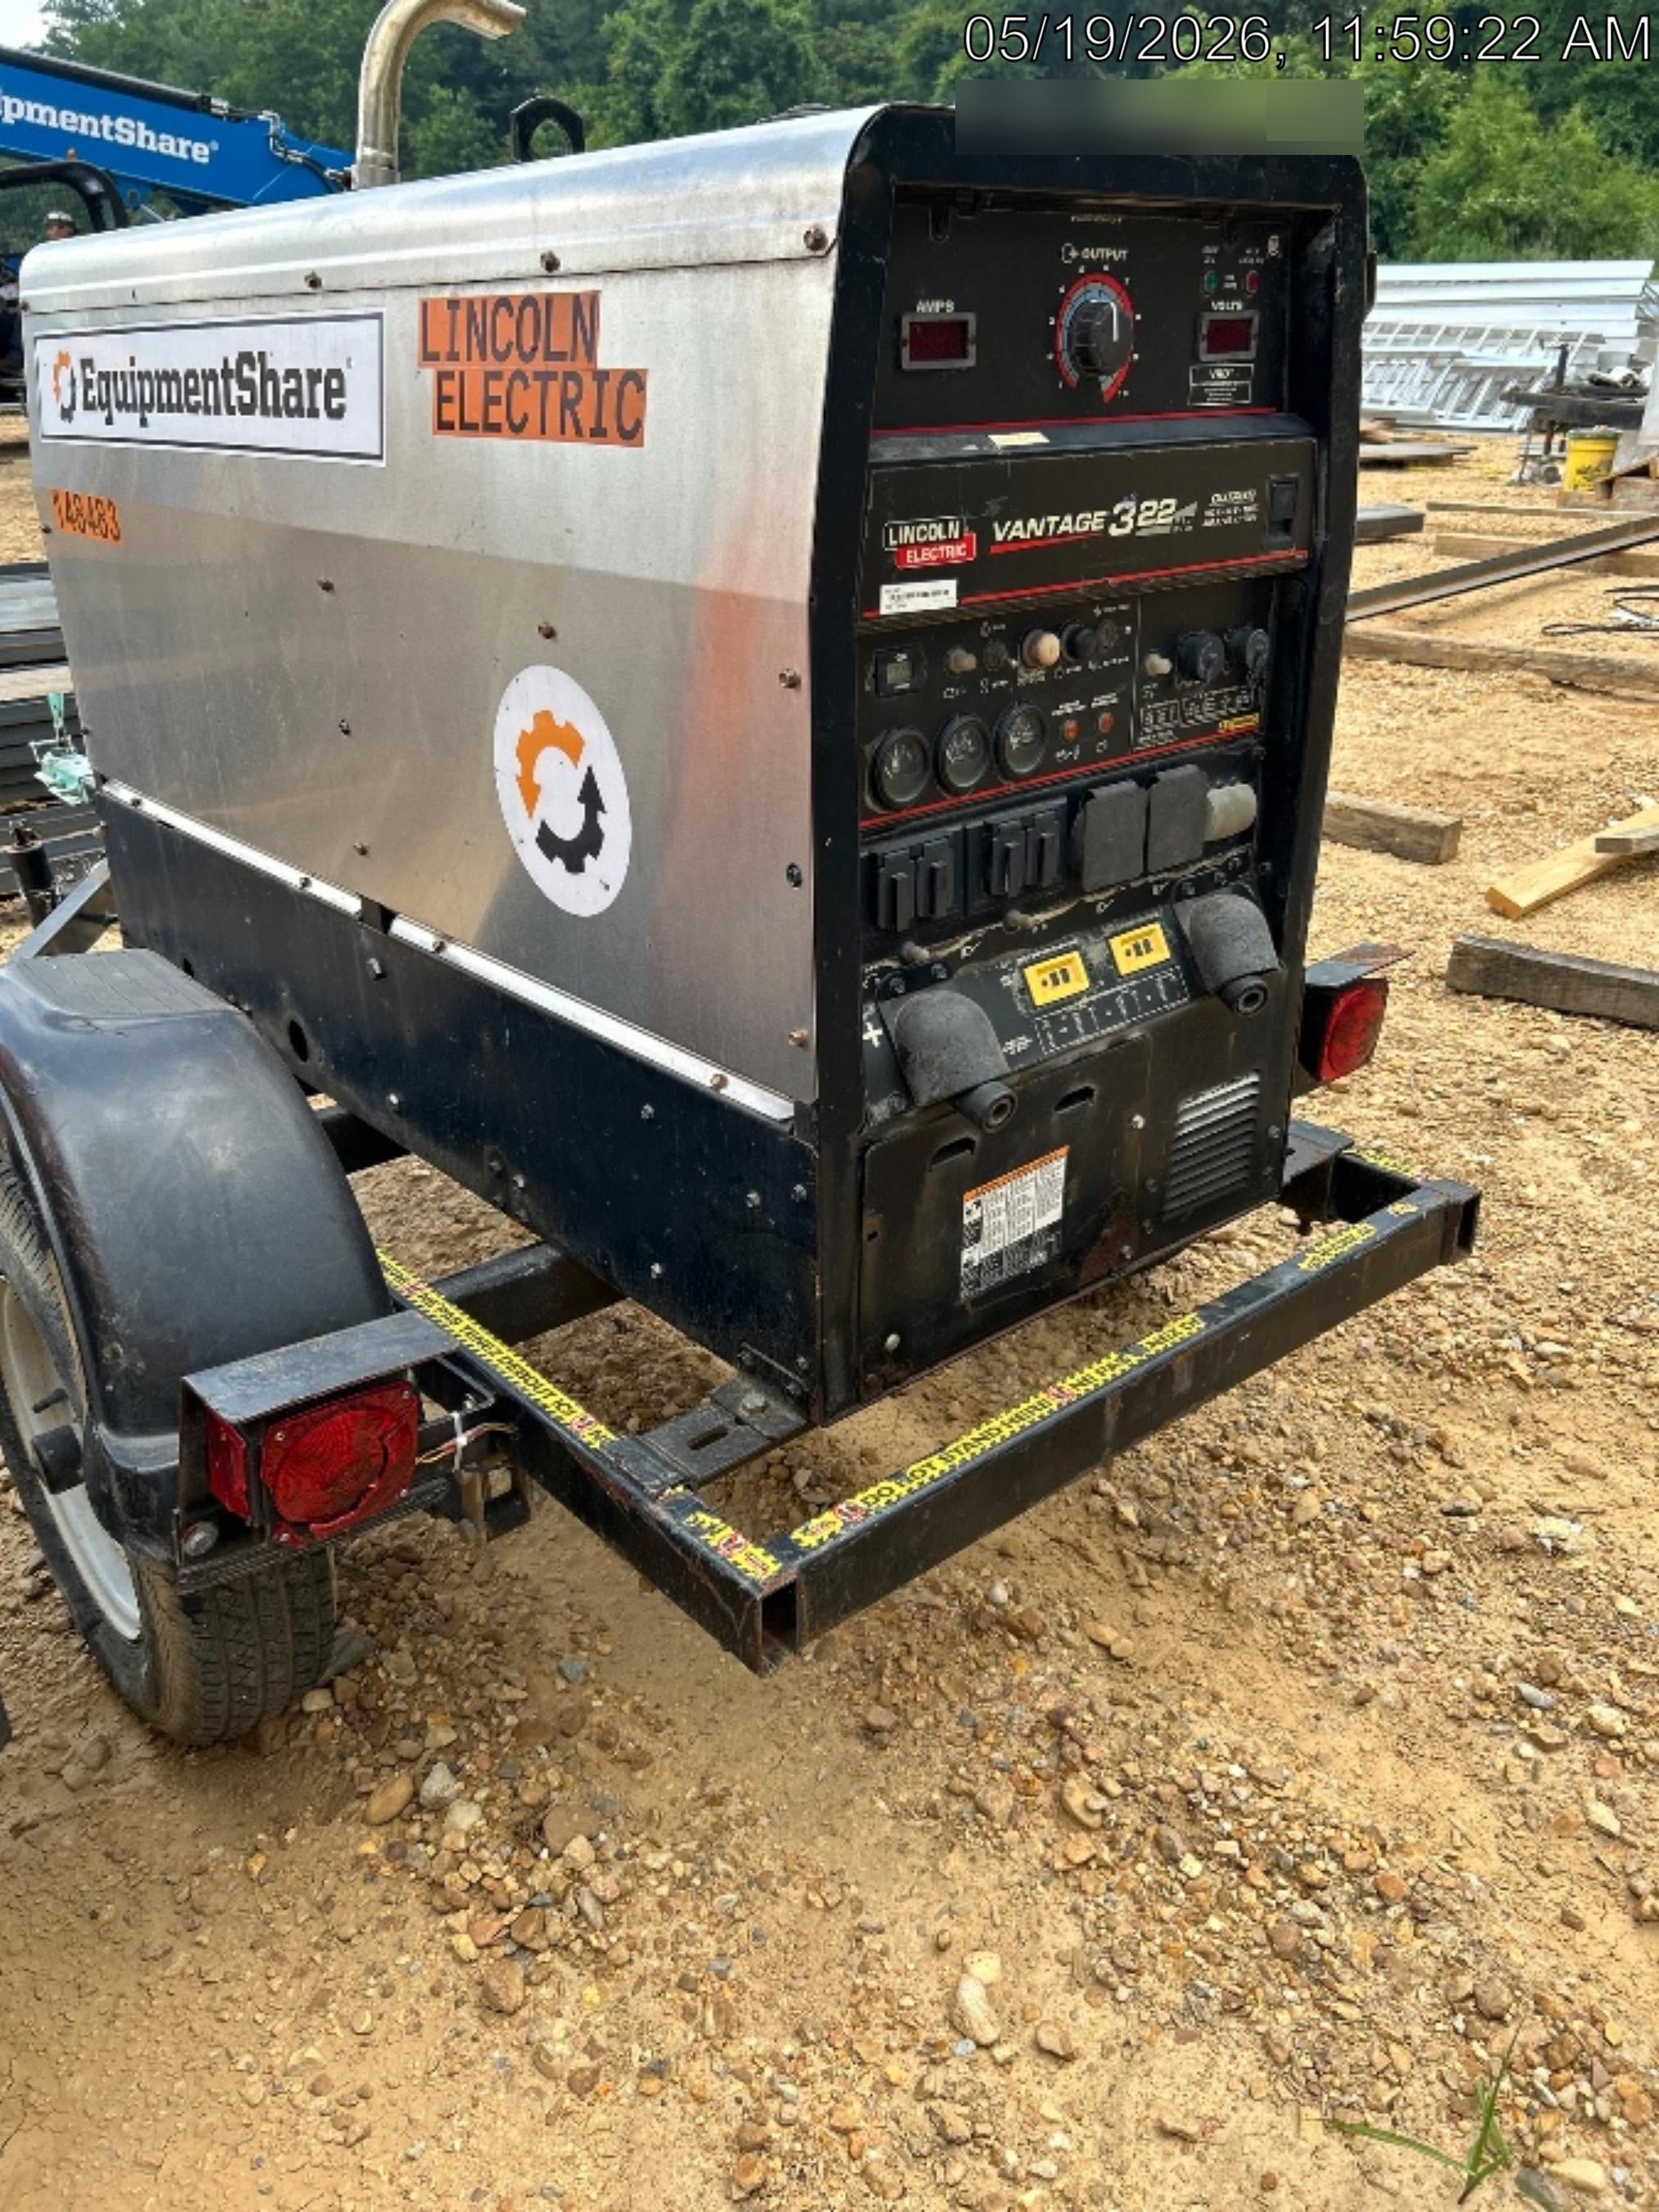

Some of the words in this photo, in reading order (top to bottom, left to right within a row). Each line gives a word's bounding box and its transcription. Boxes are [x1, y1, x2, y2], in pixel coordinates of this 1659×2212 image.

[1081, 247, 1129, 261] OUTPUT
[916, 299, 954, 313] AMPS
[421, 293, 601, 364] LINCOLN
[79, 350, 347, 428] EquipmentShare
[436, 368, 646, 441] ELECTRIC
[888, 519, 961, 547] LINCOLN
[991, 510, 1108, 542] VANTAGE
[1108, 497, 1178, 537] 322
[905, 542, 968, 564] ELECTRIC
[860, 1485, 895, 1506] DO
